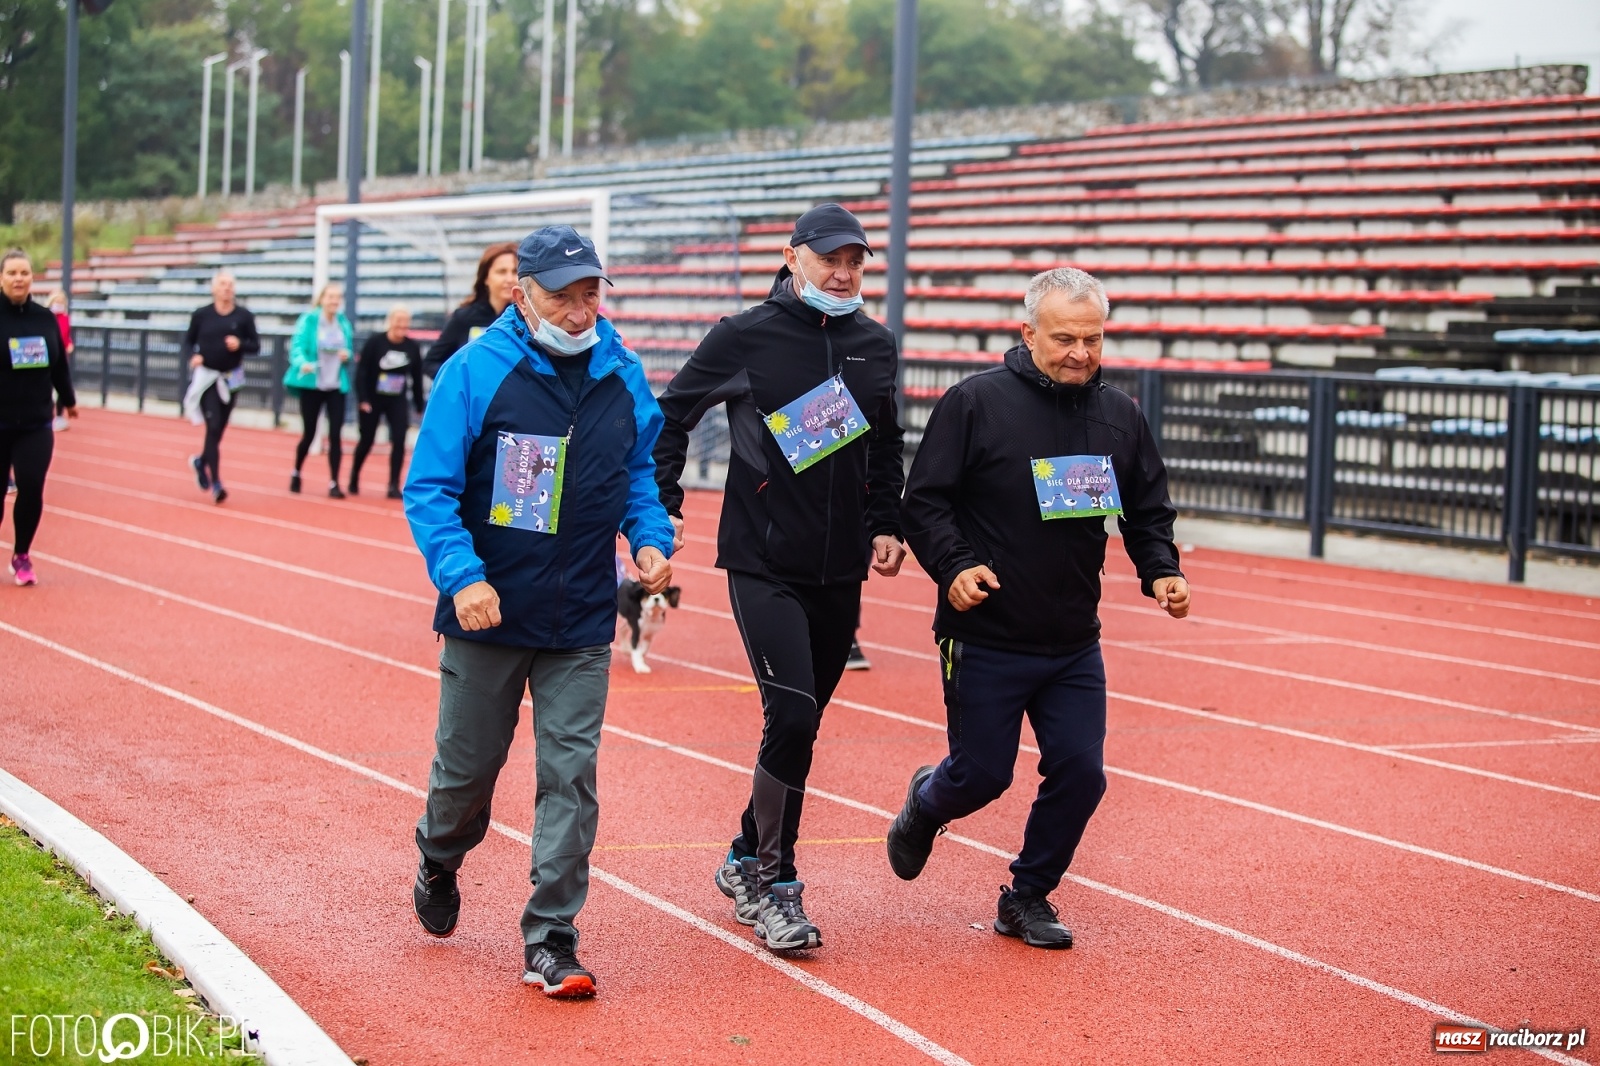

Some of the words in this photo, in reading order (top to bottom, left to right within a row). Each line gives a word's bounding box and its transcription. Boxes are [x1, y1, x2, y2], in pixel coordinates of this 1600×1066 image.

[785, 424, 803, 439] BIEG
[804, 416, 820, 428] DLA
[831, 417, 858, 439] 095
[542, 445, 557, 477] 325
[517, 478, 526, 494] DLA
[1047, 479, 1063, 487] BIEG
[1067, 478, 1081, 486] DLA
[514, 498, 524, 517] BIEG
[1090, 495, 1114, 510] 281
